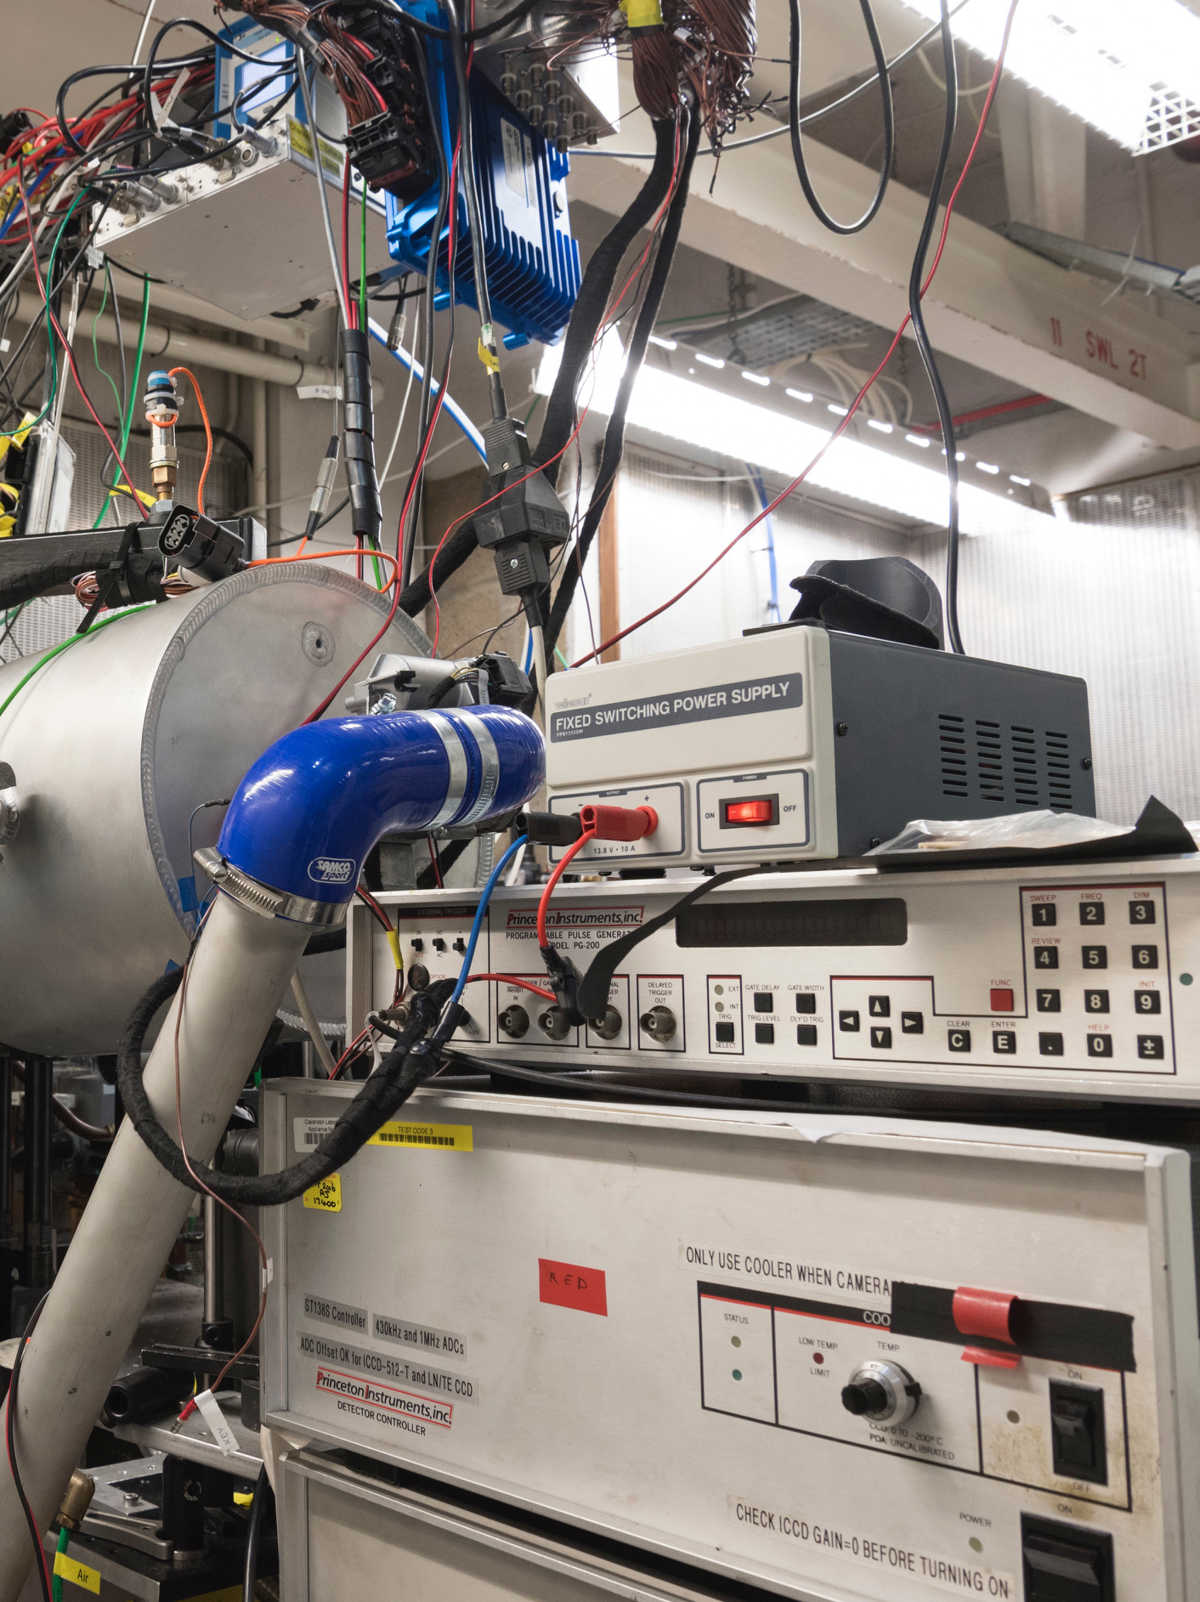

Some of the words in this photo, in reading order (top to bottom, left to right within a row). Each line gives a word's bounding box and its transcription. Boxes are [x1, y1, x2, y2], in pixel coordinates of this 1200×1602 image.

[1086, 330, 1118, 369] SWL
[556, 714, 591, 731] FIXED
[595, 698, 670, 726] SWITCHING
[674, 691, 727, 713] POWER
[731, 681, 790, 704] SUPPLY
[783, 804, 797, 813] OFF
[316, 860, 350, 871] SAMCO
[507, 912, 556, 926] Princeon
[1040, 909, 1047, 921] 1
[1086, 908, 1096, 920] 2
[1136, 906, 1146, 920] 3
[568, 931, 592, 939] PULSE
[574, 941, 600, 950] PG-200
[1040, 952, 1049, 964] 4
[1089, 952, 1099, 964] 5
[1139, 951, 1150, 964] 6
[1042, 994, 1051, 1007] 7
[1091, 995, 1101, 1008] 8
[1141, 996, 1152, 1009] 9
[951, 1034, 963, 1047] C
[998, 1036, 1008, 1049] E
[1093, 1039, 1103, 1052] 0
[686, 1246, 715, 1267] ONLY
[719, 1252, 741, 1271] USE
[745, 1256, 793, 1280] COOLER
[796, 1264, 832, 1286] WHEN
[836, 1271, 891, 1297] CAMERA
[724, 1313, 749, 1325] STATUS
[863, 1310, 891, 1327] COO
[332, 1306, 366, 1329] Controller
[376, 1319, 402, 1335] 430kHz
[404, 1328, 417, 1343] and
[420, 1331, 440, 1349] 1MHz
[443, 1335, 465, 1355] ADCs
[799, 1336, 814, 1347] LOW
[816, 1339, 838, 1351] TEMP
[877, 1341, 900, 1352] TEMP
[301, 1337, 314, 1351] ADC
[316, 1341, 338, 1358] Offset
[340, 1347, 349, 1361] OK
[352, 1351, 361, 1366] for
[412, 1369, 426, 1385] and
[428, 1371, 452, 1392] LN/TE
[455, 1378, 473, 1398] CCD
[810, 1367, 831, 1378] LIMIT
[316, 1371, 365, 1396] Princeton
[337, 1401, 375, 1420] DETECTOR
[376, 1413, 426, 1436] CONTROLLER
[1058, 1503, 1073, 1514] ON
[960, 1512, 991, 1528] POWER
[736, 1503, 775, 1532] CHECK
[779, 1515, 809, 1541] ICCD
[813, 1528, 860, 1556] GAIN=0
[863, 1541, 915, 1572] BEFORE
[920, 1555, 985, 1591] TURNING
[988, 1577, 1009, 1599] ON
[77, 1568, 89, 1584] Air
